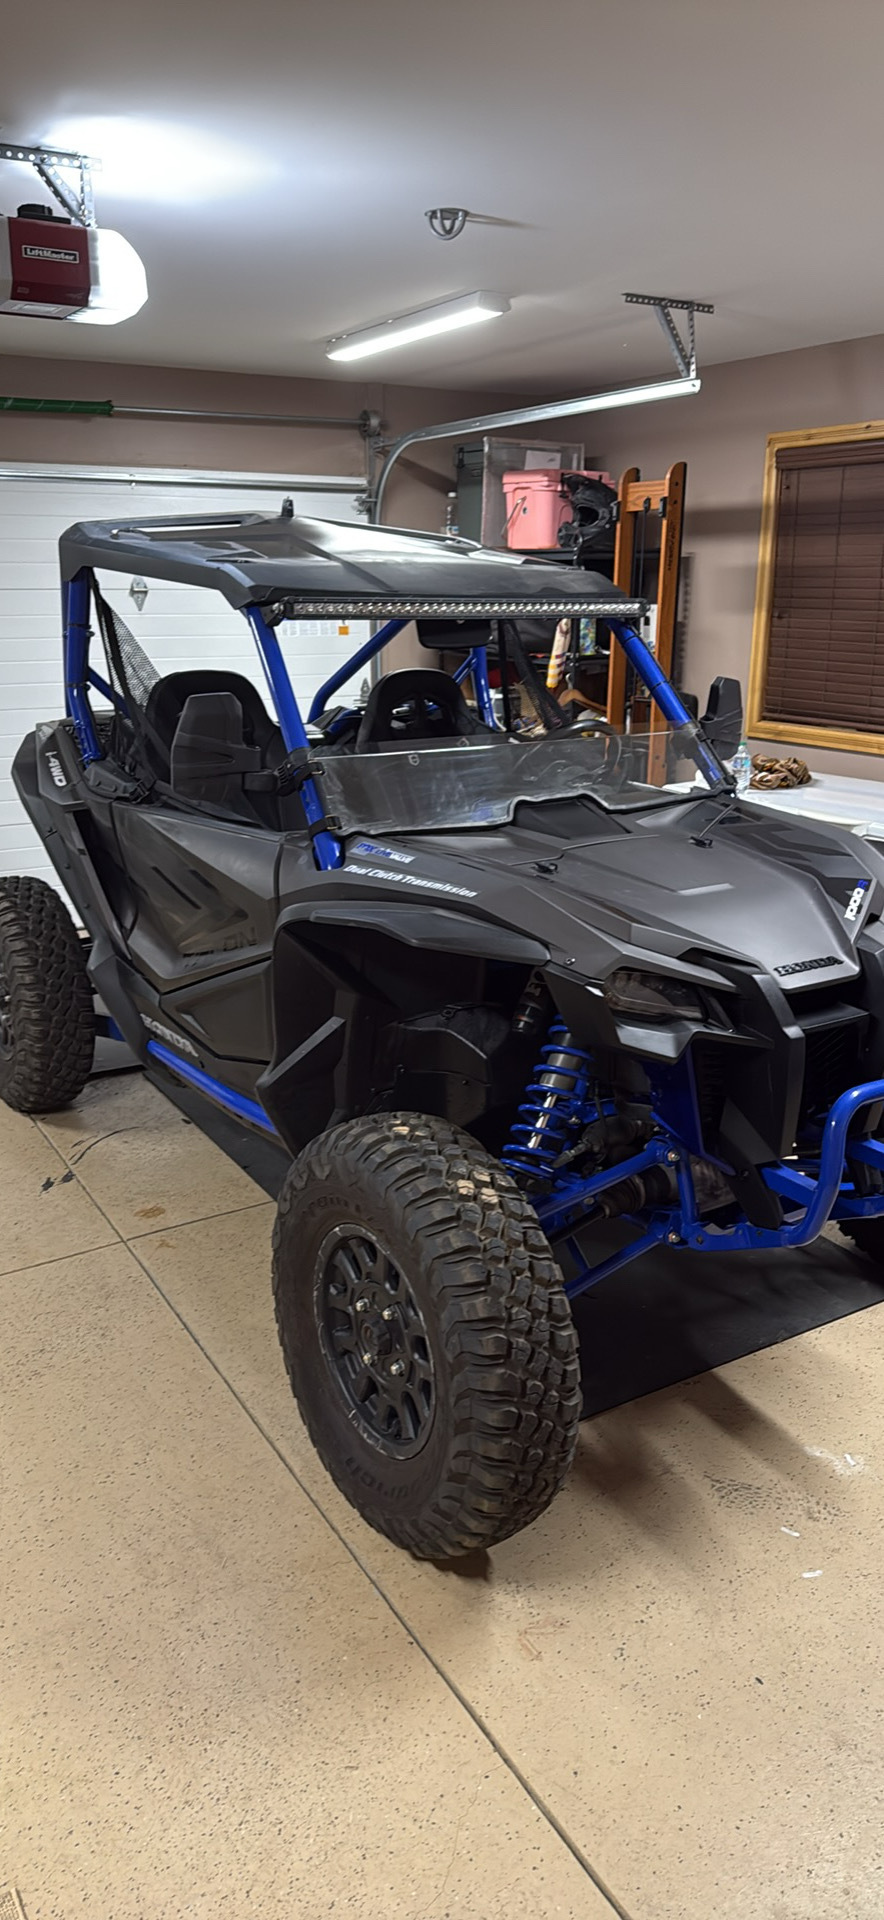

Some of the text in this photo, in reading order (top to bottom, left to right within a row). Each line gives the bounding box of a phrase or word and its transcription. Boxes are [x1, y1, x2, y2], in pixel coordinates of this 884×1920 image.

[26, 248, 75, 260] LiftMaster
[343, 865, 478, 897] Dual Clutch Transmission
[773, 956, 844, 976] HONDA
[140, 1013, 199, 1057] HONDA
